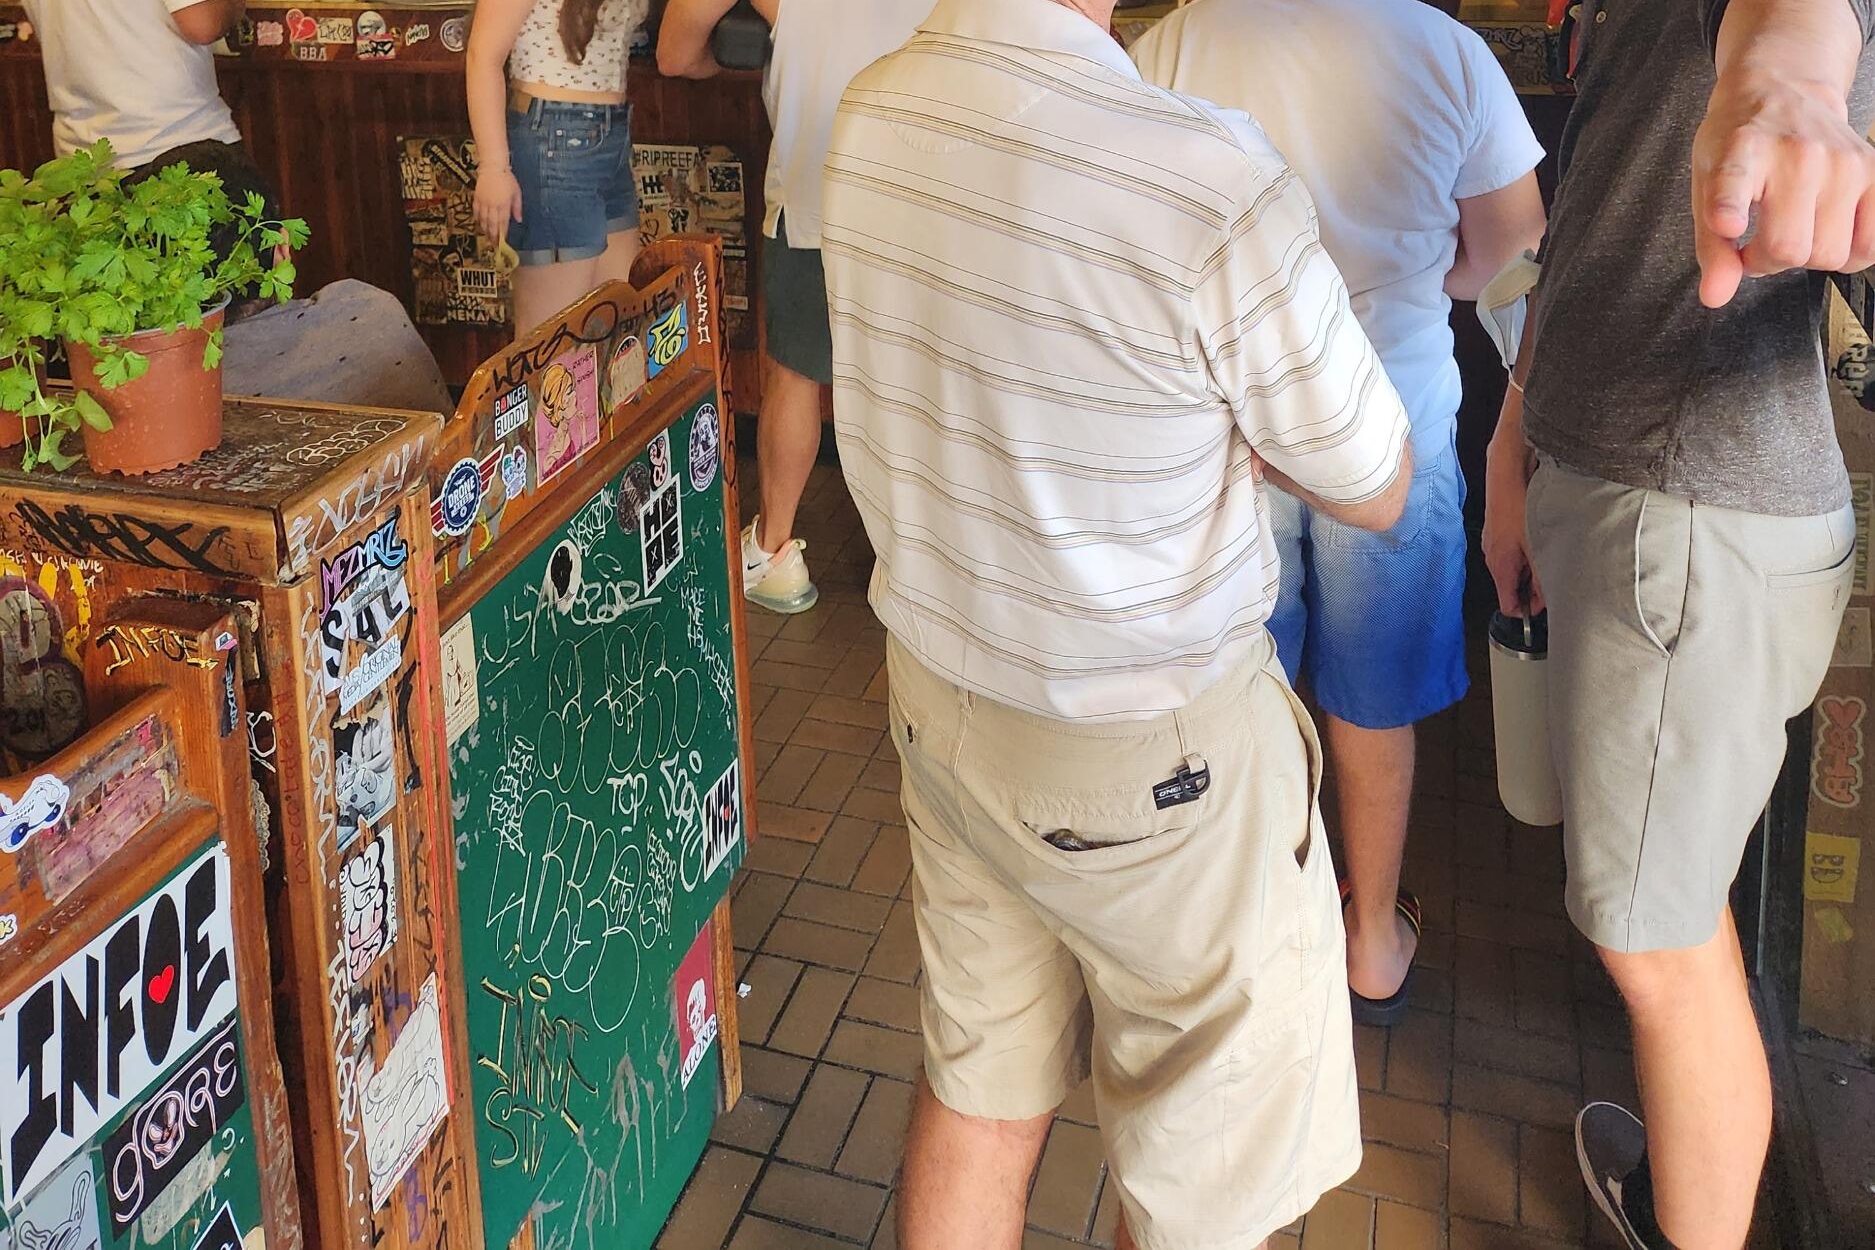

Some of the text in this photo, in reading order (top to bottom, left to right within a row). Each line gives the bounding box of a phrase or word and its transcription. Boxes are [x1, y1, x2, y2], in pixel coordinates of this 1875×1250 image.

[460, 270, 495, 287] WHUT
[496, 402, 527, 438] BUDDY
[447, 475, 475, 509] DRONE
[683, 1016, 717, 1086] ALONE
